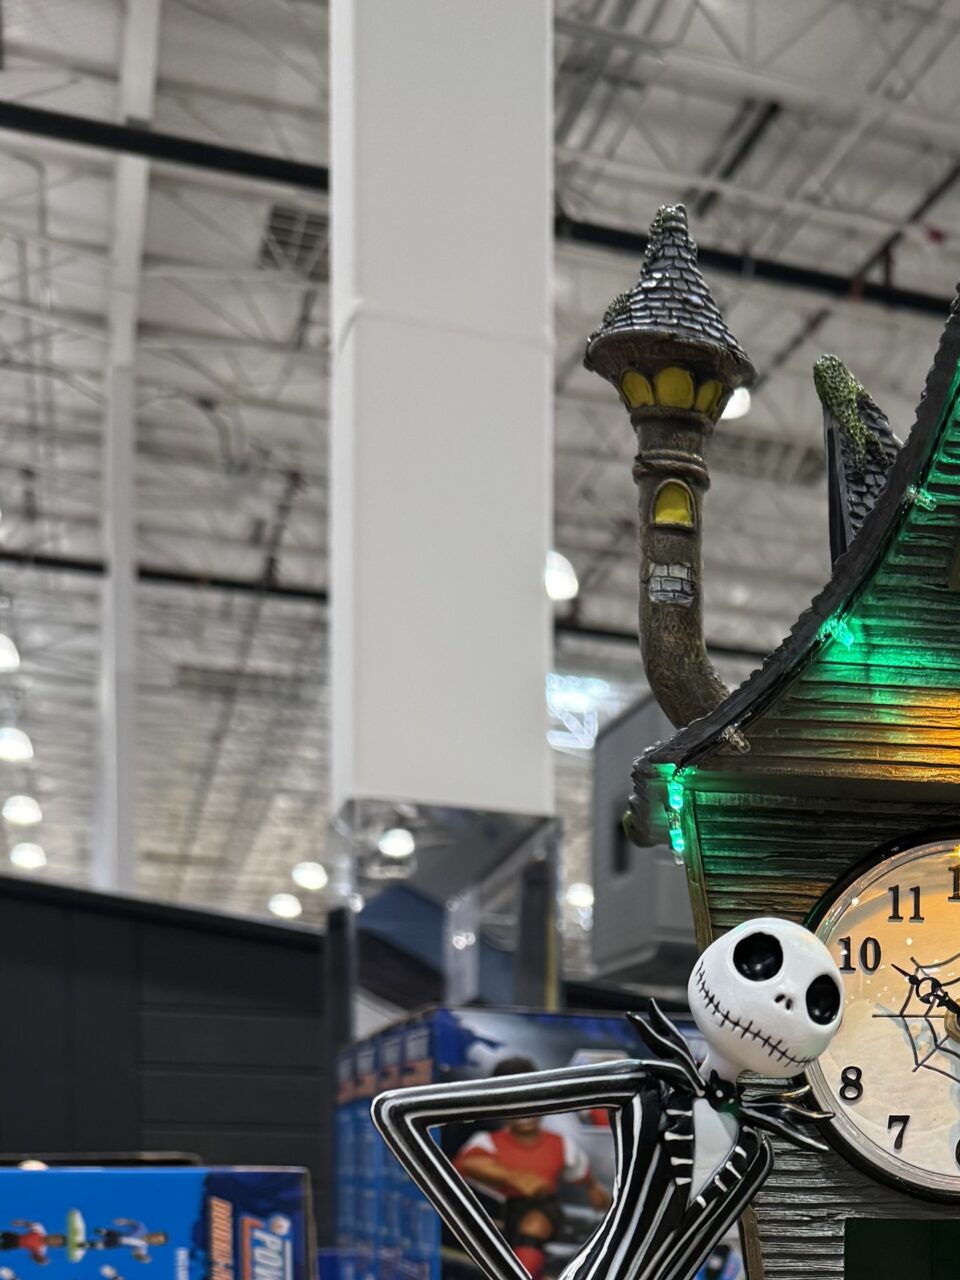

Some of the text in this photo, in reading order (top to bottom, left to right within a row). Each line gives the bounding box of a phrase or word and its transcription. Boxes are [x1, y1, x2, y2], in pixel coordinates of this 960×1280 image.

[887, 884, 925, 923] 11
[838, 936, 882, 972] 10
[839, 1065, 864, 1101] 8
[887, 1115, 911, 1150] 7
